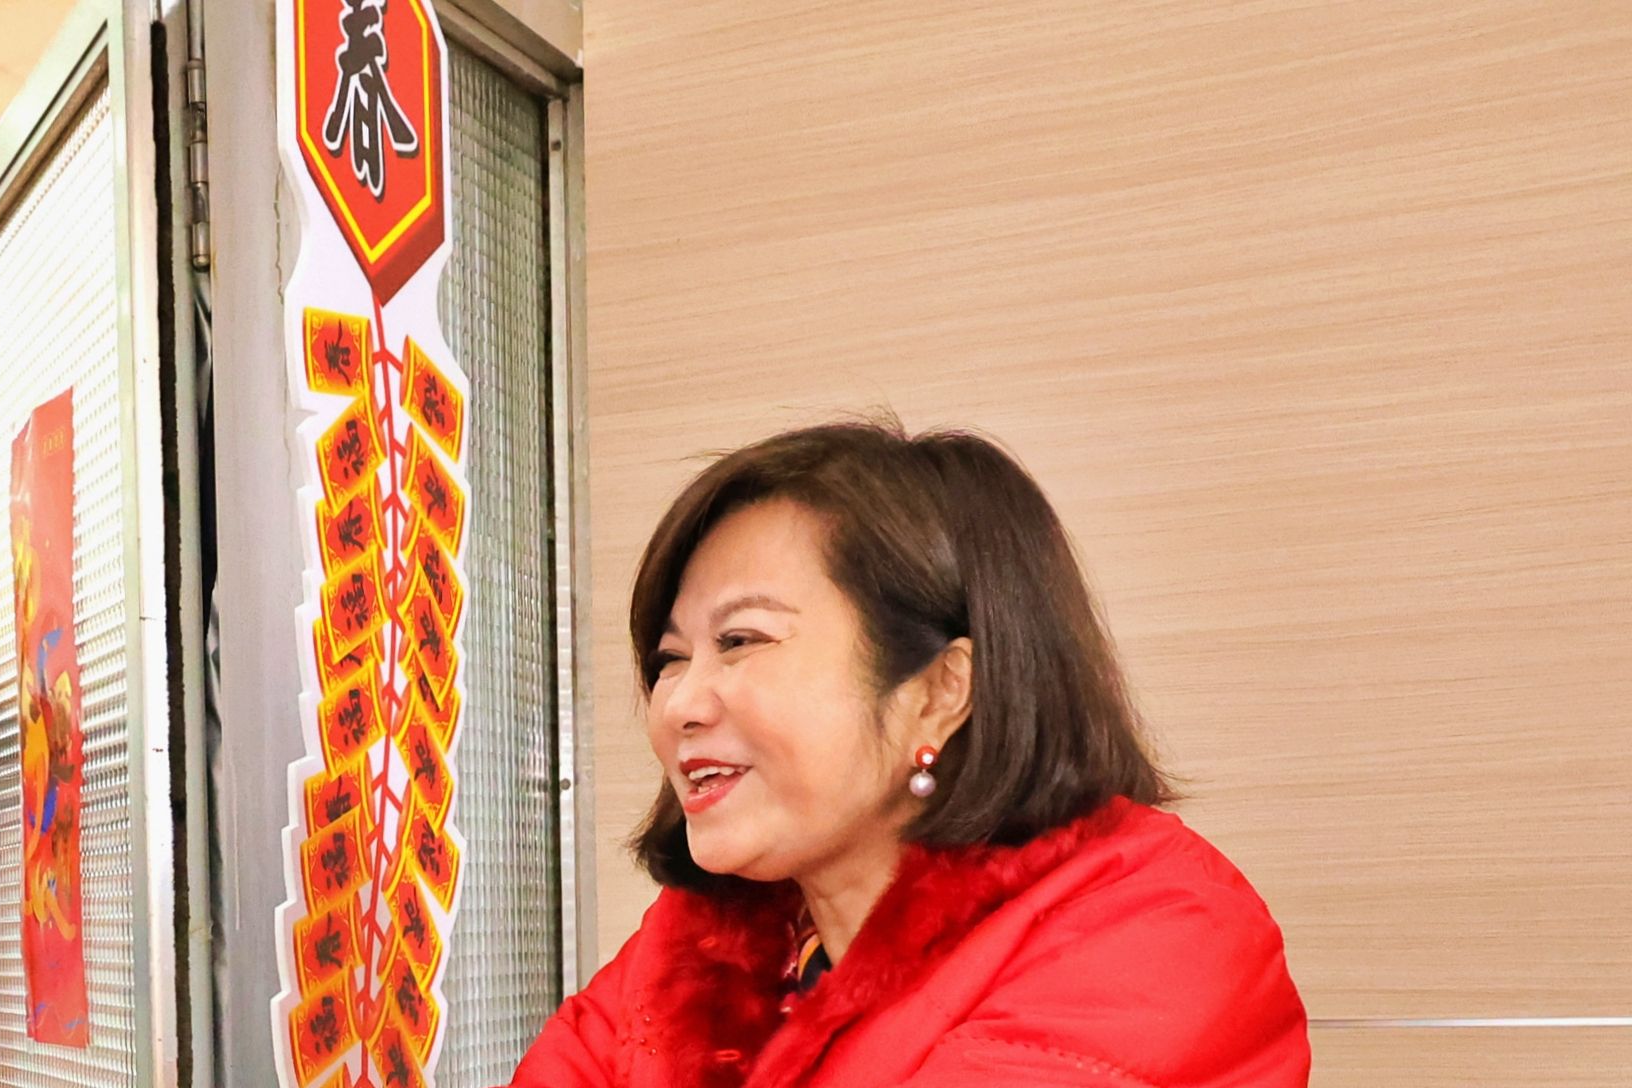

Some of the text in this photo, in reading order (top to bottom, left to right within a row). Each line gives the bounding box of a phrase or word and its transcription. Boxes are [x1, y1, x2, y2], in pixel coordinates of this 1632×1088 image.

[324, 319, 352, 386] 春
[424, 374, 445, 428] 福
[338, 419, 365, 479] 福
[338, 500, 365, 551] 春
[341, 573, 368, 630] 福
[338, 690, 365, 745] 福
[321, 832, 352, 891] 福
[310, 996, 339, 1054] 福
